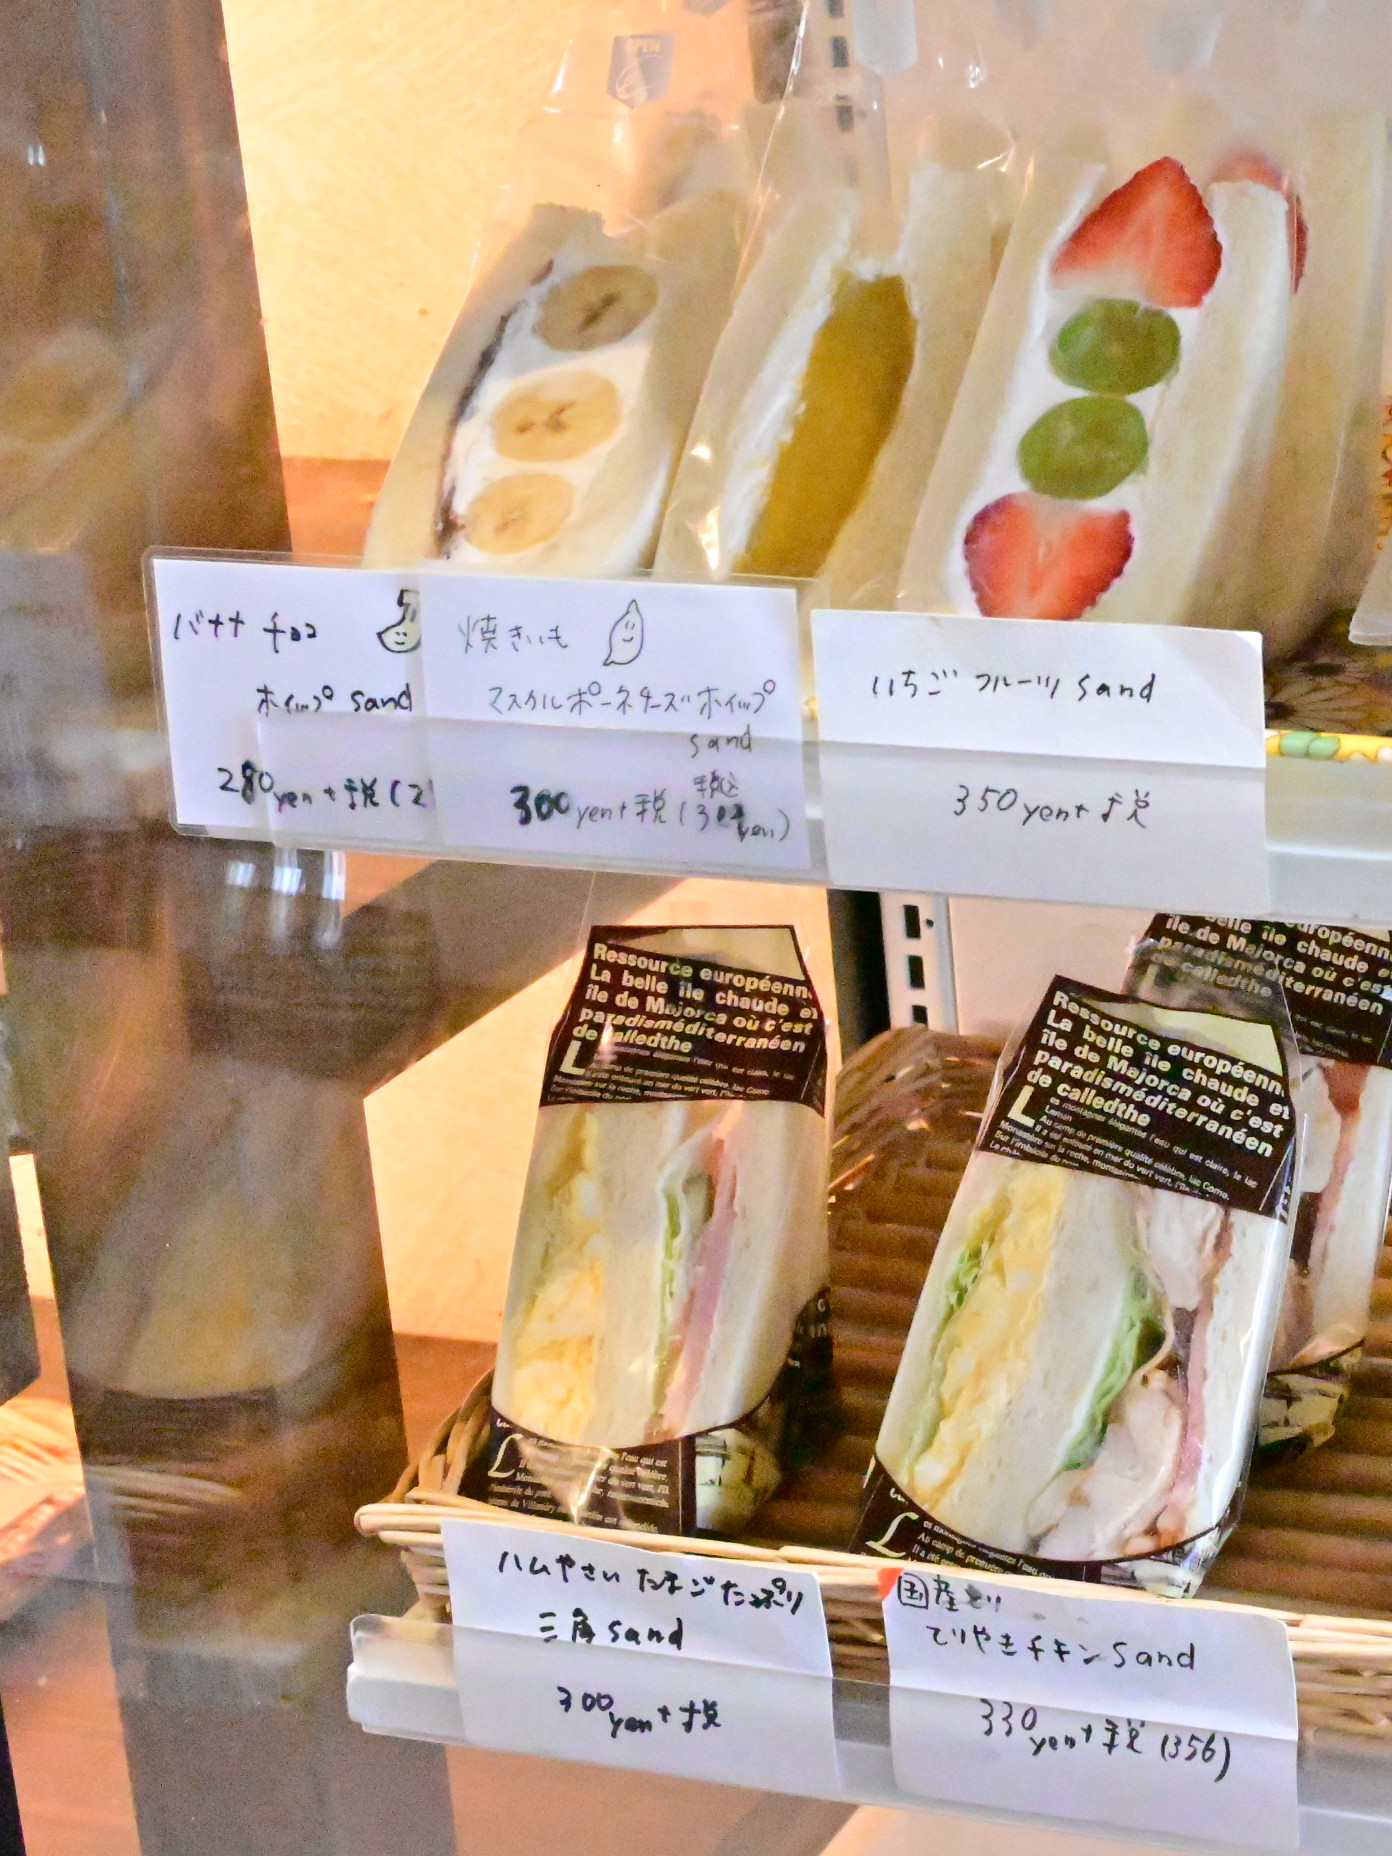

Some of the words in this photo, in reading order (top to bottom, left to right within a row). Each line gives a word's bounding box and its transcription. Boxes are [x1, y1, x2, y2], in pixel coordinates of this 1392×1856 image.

[457, 613, 568, 654] 焼きいも
[593, 942, 693, 978] Ressource
[1196, 926, 1220, 944] de
[1226, 934, 1307, 974] Majorca
[1297, 939, 1369, 974] chaude
[590, 962, 611, 983] La
[622, 969, 668, 994] belle
[715, 989, 790, 1016] chaude
[614, 991, 639, 1010] de
[646, 996, 728, 1025] Majorca
[573, 1023, 598, 1041] de
[1053, 990, 1161, 1051] Ressource
[1046, 1009, 1073, 1032] La
[1082, 1024, 1134, 1058] belle
[1182, 1067, 1259, 1107] chaude
[1027, 1067, 1052, 1088] de
[1057, 1083, 1151, 1127] calledthe
[1040, 1028, 1068, 1051] île
[1074, 1044, 1100, 1063] de
[1107, 1055, 1192, 1101] Majorca
[1197, 1094, 1225, 1115] où
[1230, 1109, 1284, 1139] c'est
[1160, 1733, 1232, 1783] (356)
